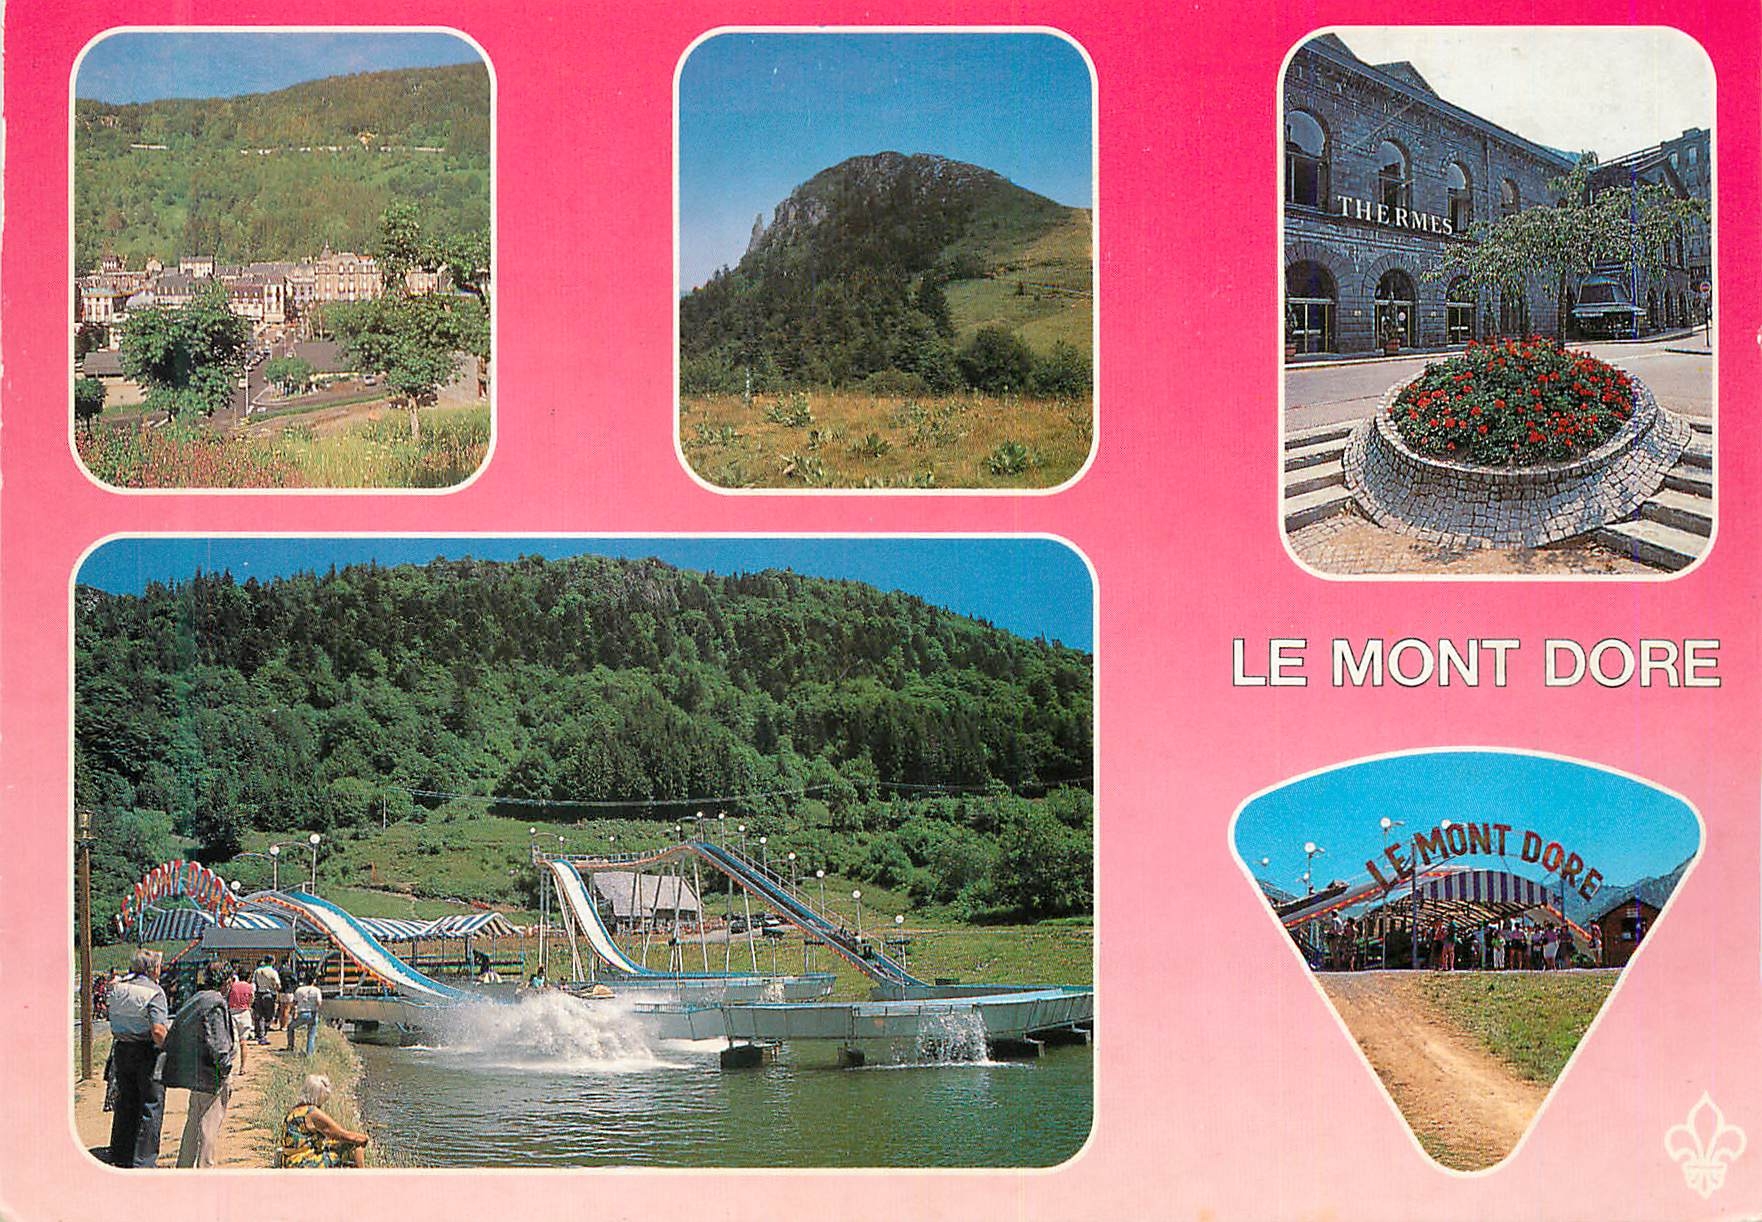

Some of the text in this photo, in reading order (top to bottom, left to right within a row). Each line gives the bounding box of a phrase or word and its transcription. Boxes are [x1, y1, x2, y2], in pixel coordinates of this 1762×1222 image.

[1337, 195, 1453, 236] THERMES
[135, 859, 185, 916] MONT
[1366, 822, 1604, 900] LE MONT DORE
